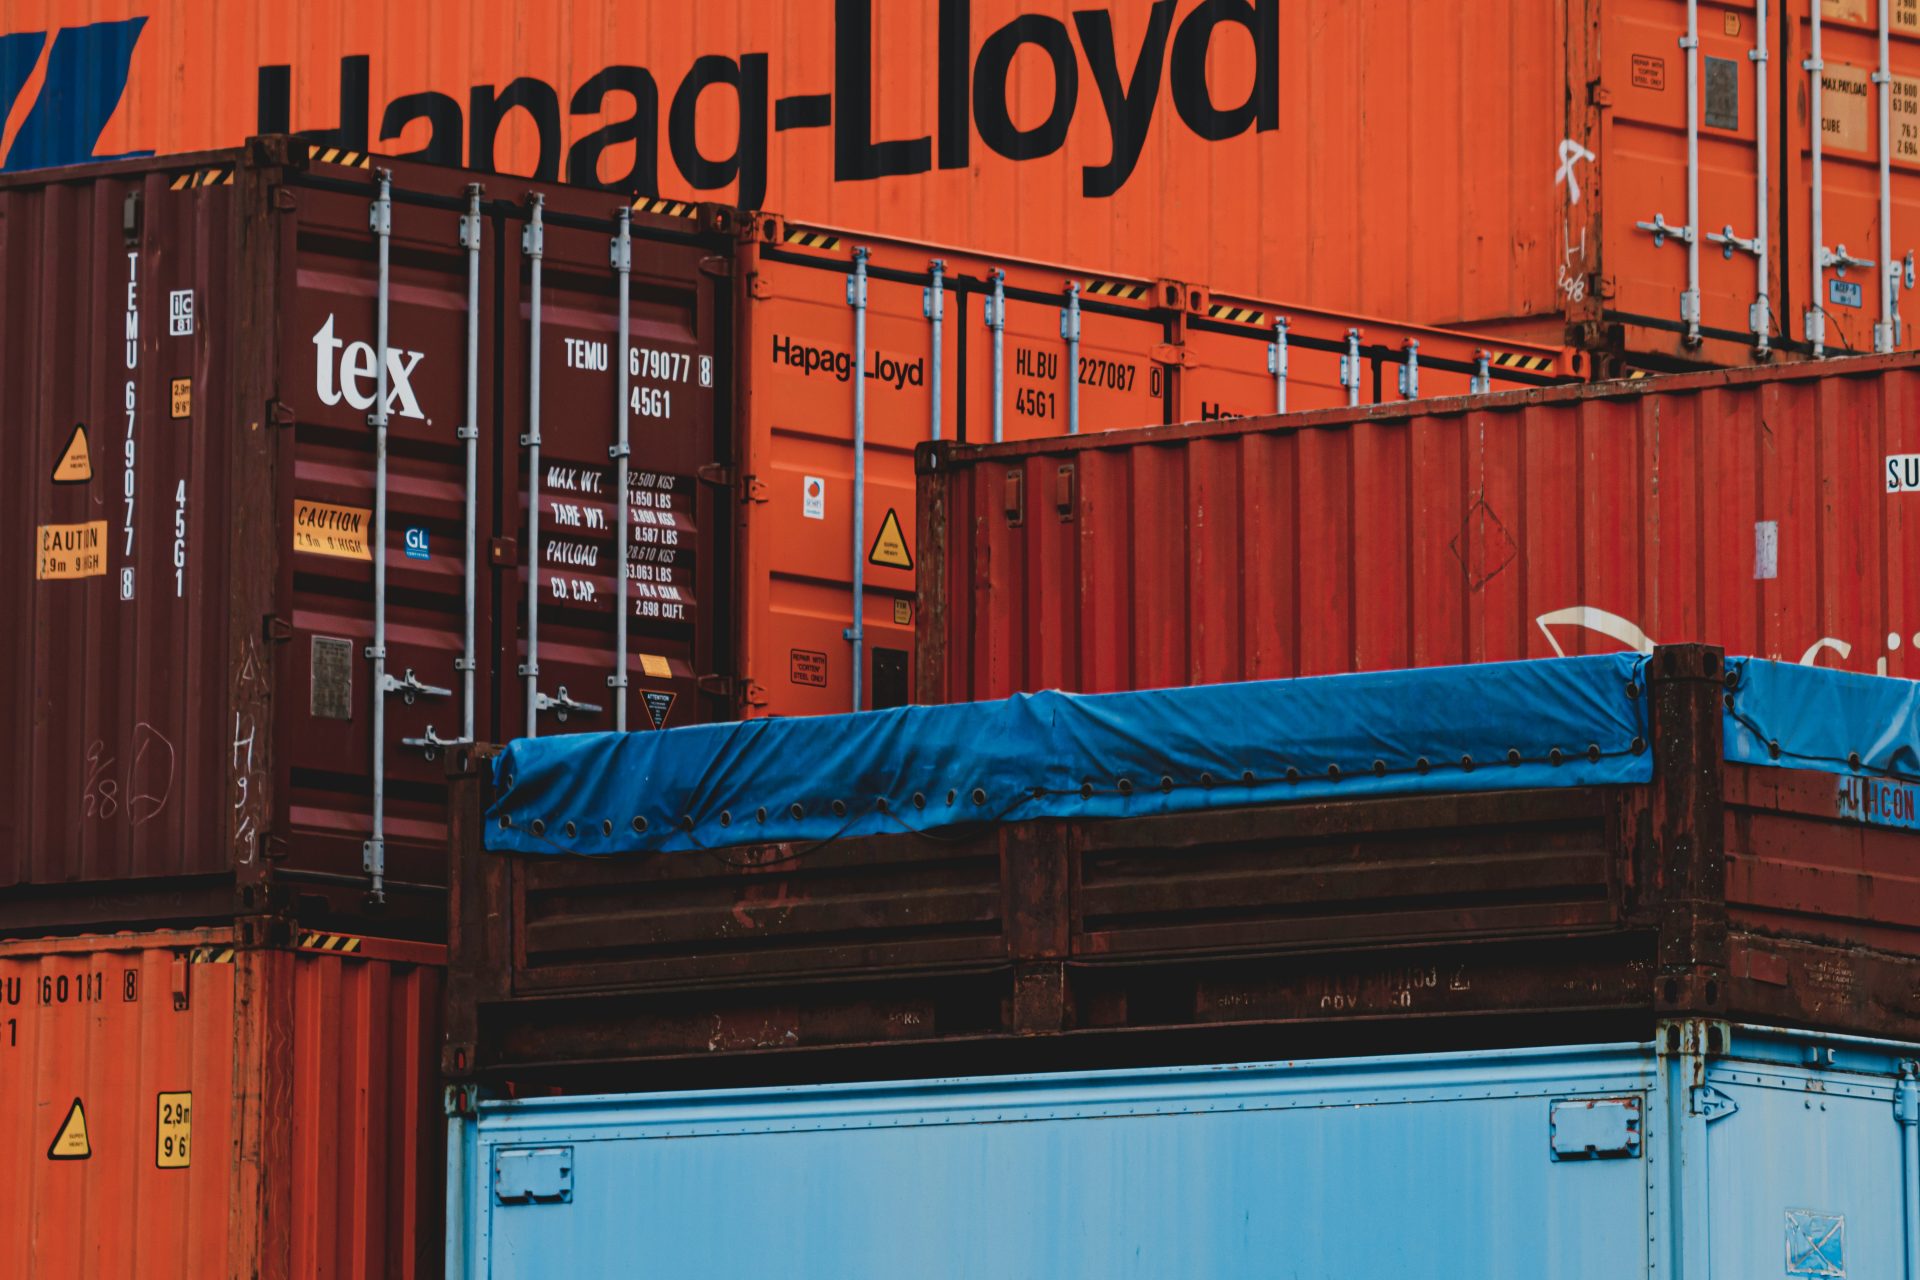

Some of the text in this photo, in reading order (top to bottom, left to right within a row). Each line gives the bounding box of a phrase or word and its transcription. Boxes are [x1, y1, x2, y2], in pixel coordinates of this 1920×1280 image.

[258, 0, 1279, 211] Hapag-Lloyd
[1821, 117, 1840, 134] CUBE
[564, 337, 713, 387] TEMU 679077 8
[1016, 348, 1057, 380] HLBU
[1078, 356, 1136, 392] 227087
[630, 386, 671, 419] 45G1
[1016, 388, 1056, 420] 45G1
[122, 252, 139, 600] TEMU 679077 8
[547, 466, 577, 490] MAX.
[580, 471, 603, 494] WT.
[656, 475, 676, 490] KGS
[626, 490, 672, 509] 1.650 LBS
[298, 506, 361, 533] CAUTION
[551, 502, 581, 527] TARE
[583, 506, 608, 531] WT.
[656, 511, 676, 526] KGS
[43, 527, 98, 552] CAUTION
[173, 479, 187, 598] 45G1
[296, 532, 320, 548] 29m
[405, 528, 429, 549] GL
[635, 526, 678, 545] 8.587 LBS
[546, 540, 599, 567] PAYLOAD
[657, 548, 676, 563] KGS
[655, 565, 672, 583] LBS
[551, 576, 569, 599] CU.
[571, 580, 597, 603] CAP.
[635, 582, 657, 598] 76.4
[636, 600, 659, 617] 2.698
[647, 693, 670, 702] ATTENTION
[0, 976, 21, 1006] U
[125, 970, 136, 1000] 8
